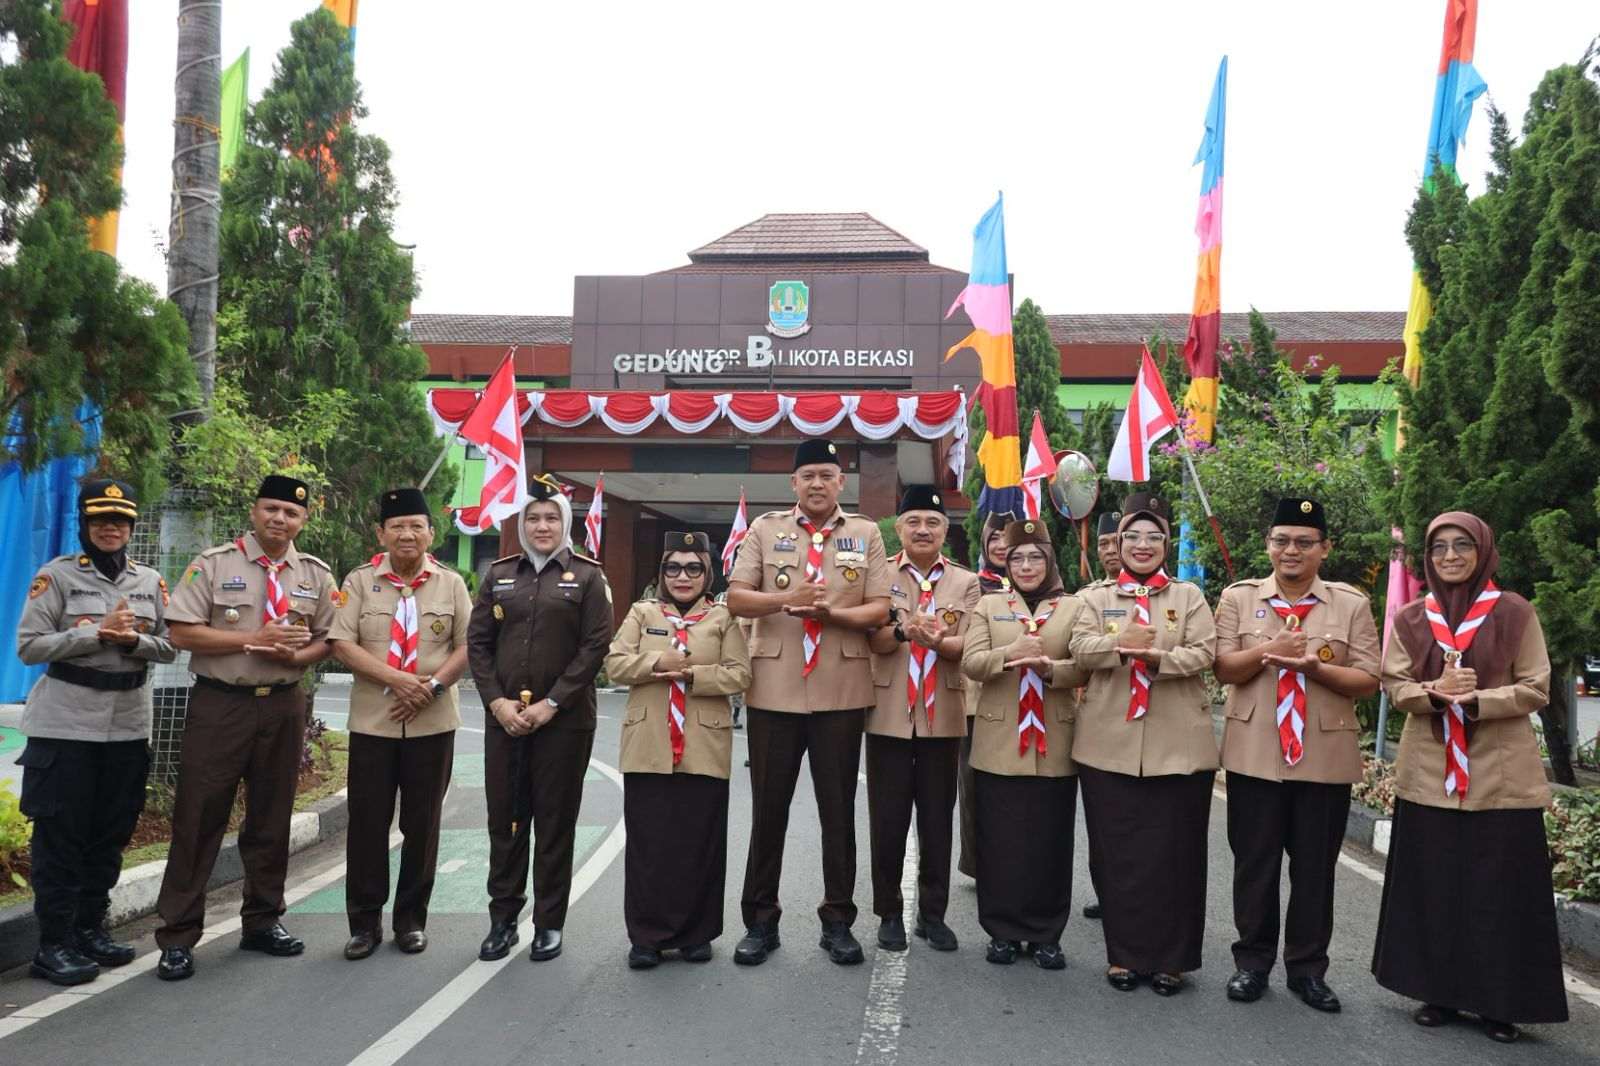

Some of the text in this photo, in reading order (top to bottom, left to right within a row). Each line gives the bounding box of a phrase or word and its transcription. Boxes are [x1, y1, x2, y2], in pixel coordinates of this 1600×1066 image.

[613, 335, 772, 373] GEDUNG B
[746, 349, 840, 367] LIKOTA
[844, 349, 914, 366] BEKASI
